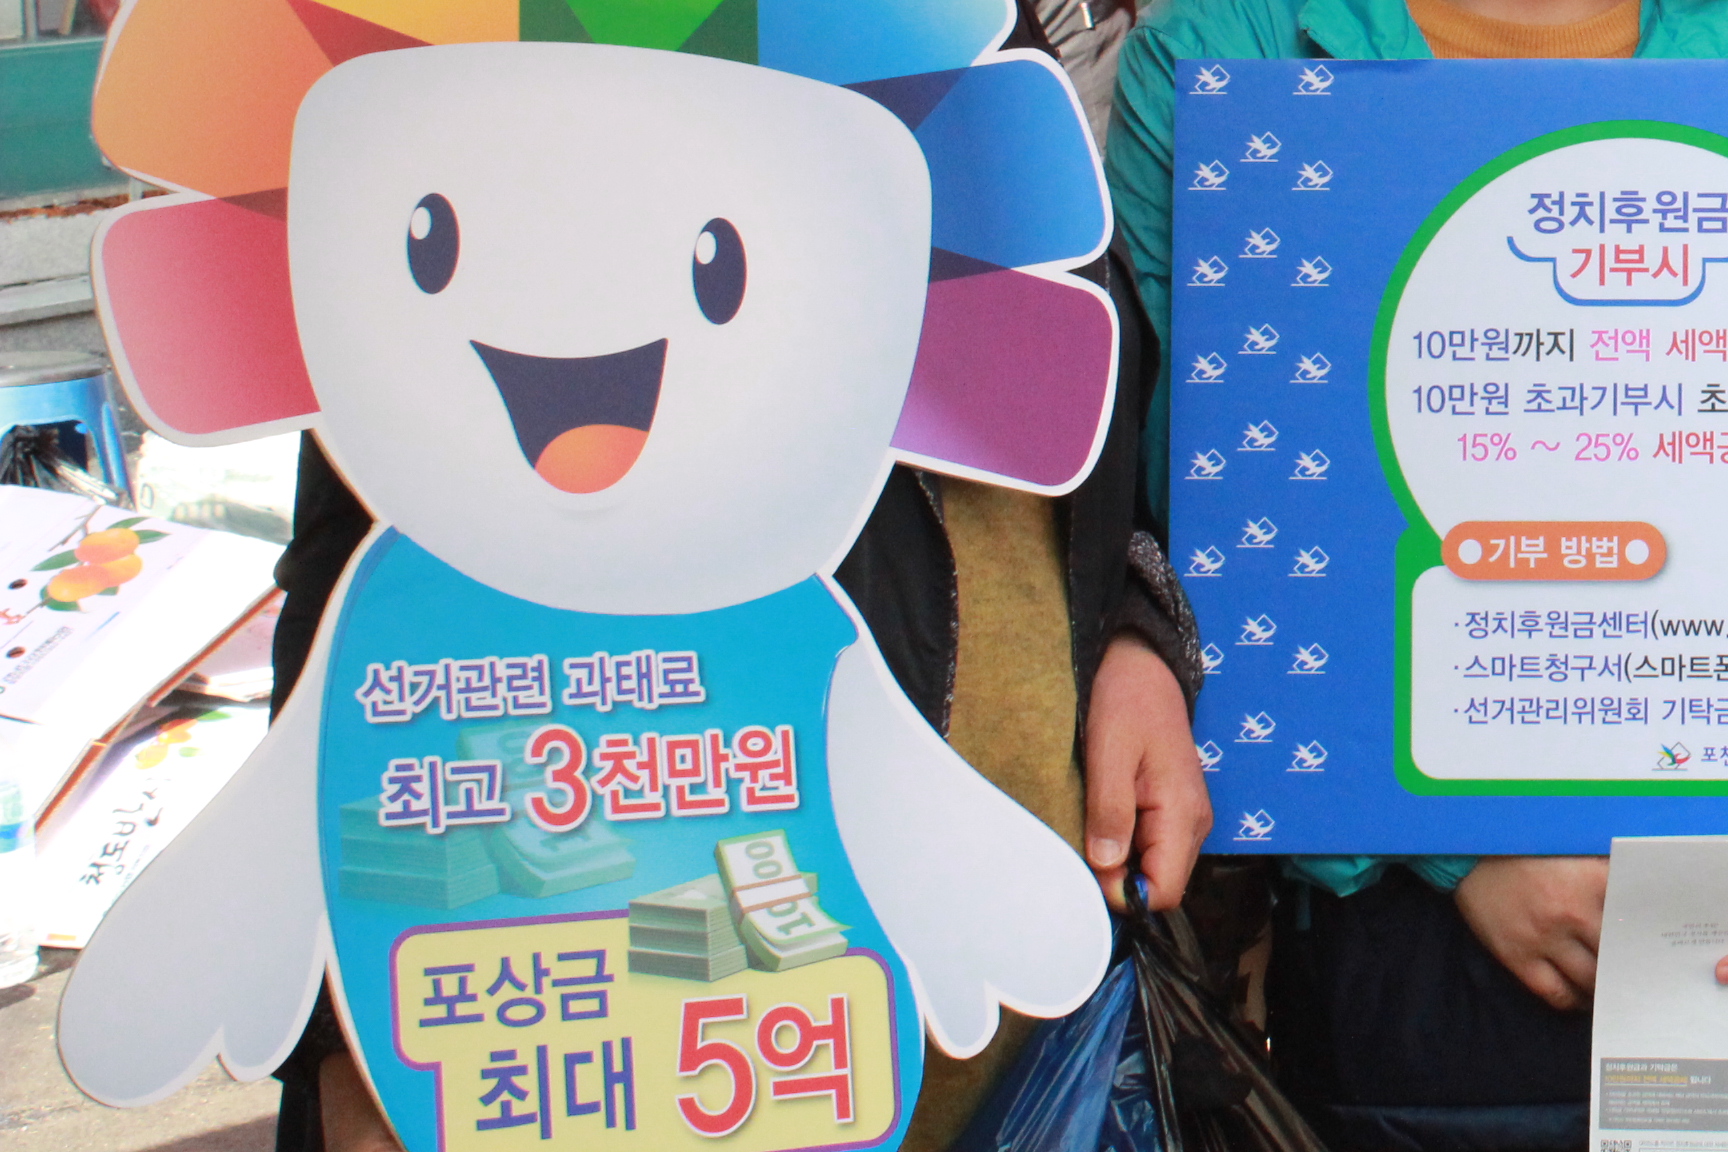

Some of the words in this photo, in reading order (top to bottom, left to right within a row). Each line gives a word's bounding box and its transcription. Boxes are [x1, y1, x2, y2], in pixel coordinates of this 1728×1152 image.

[1569, 243, 1690, 287] 기부시
[1413, 327, 1576, 363] 10만원까지
[1589, 328, 1652, 363] 전액
[1665, 328, 1728, 363] 세액
[1412, 382, 1511, 417] 10만원
[1523, 382, 1684, 417] 초과기부시
[1457, 431, 1518, 463] 15%
[1574, 431, 1641, 463] 25%
[1487, 536, 1548, 569] 기부
[1560, 536, 1620, 569] 방법
[357, 656, 550, 721] 선거관련
[565, 651, 705, 711] 과태료
[1464, 696, 1649, 725] 선거관리위원회
[380, 757, 510, 834] 최고
[527, 724, 800, 832] 3천만원
[418, 949, 615, 1030] 포상금
[475, 1037, 637, 1140] 최대
[675, 993, 855, 1139] 5억
